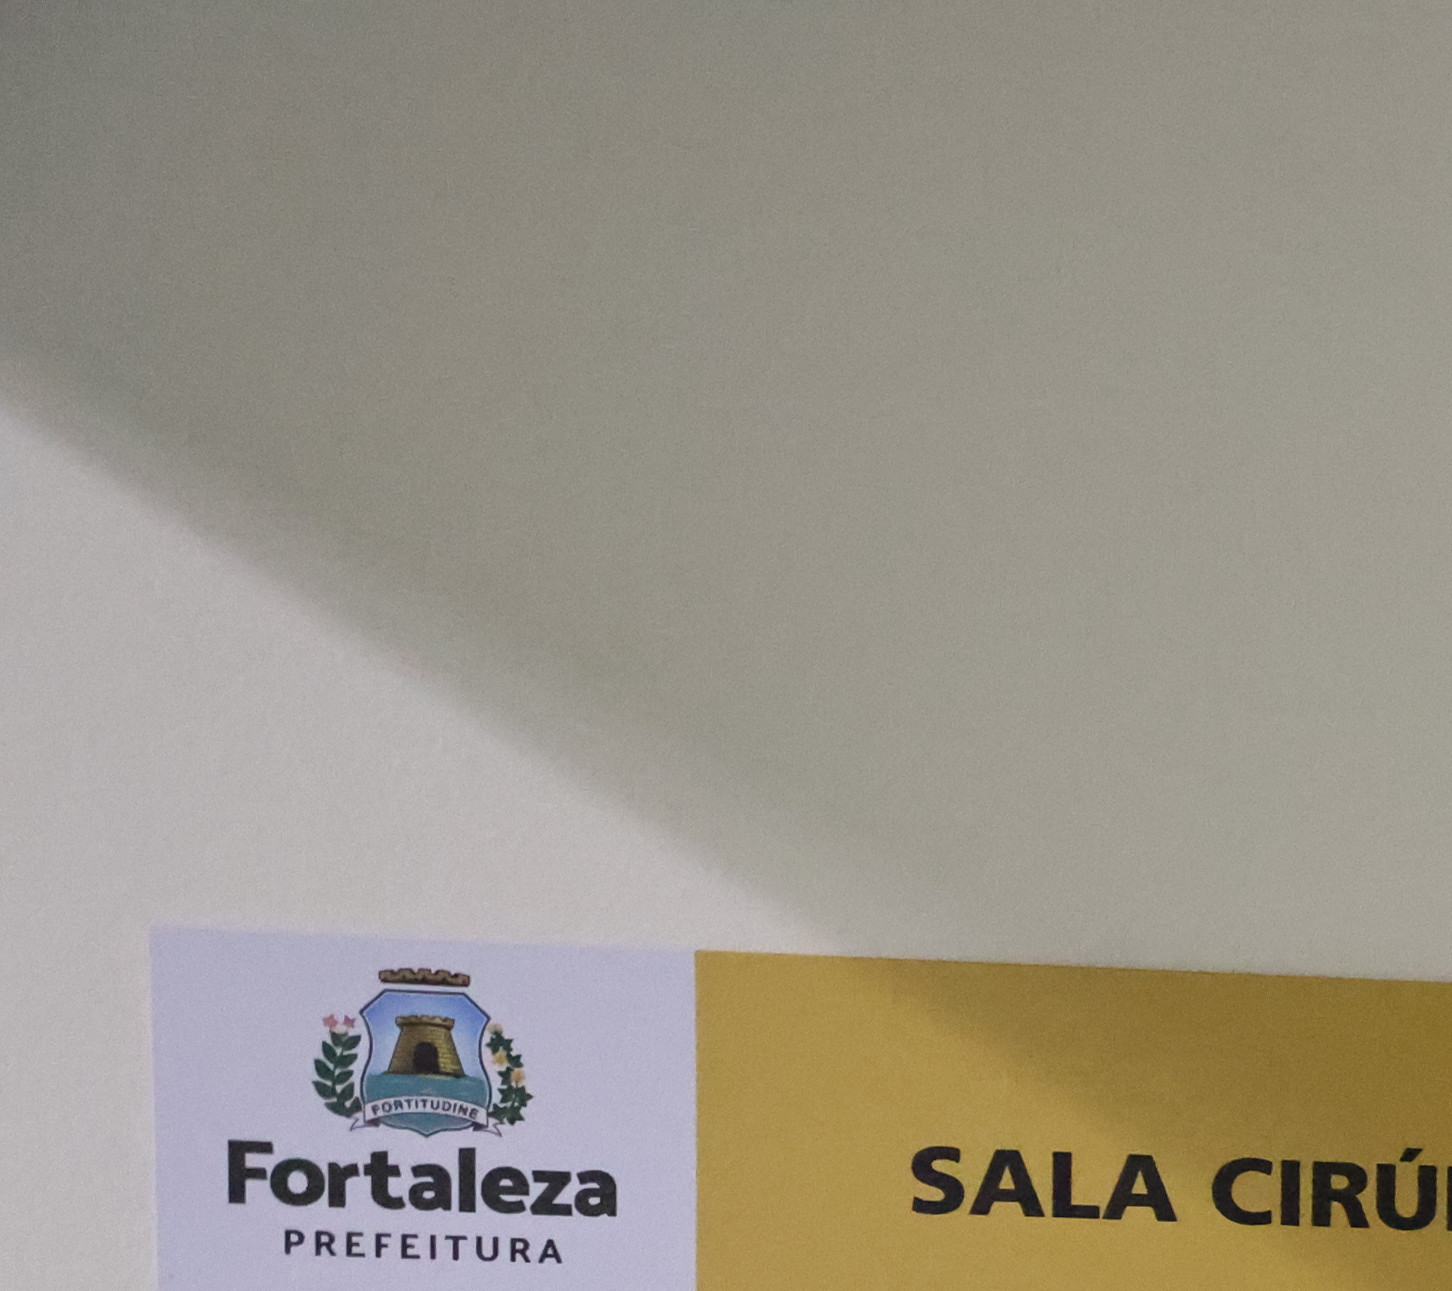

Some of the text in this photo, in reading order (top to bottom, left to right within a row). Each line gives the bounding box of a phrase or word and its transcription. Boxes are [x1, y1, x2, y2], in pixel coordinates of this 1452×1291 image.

[371, 1098, 479, 1119] FORTITUDINE
[227, 1139, 618, 1218] Fortaleza
[909, 1145, 1178, 1223] SALA
[284, 1229, 563, 1264] PREFEITURA
